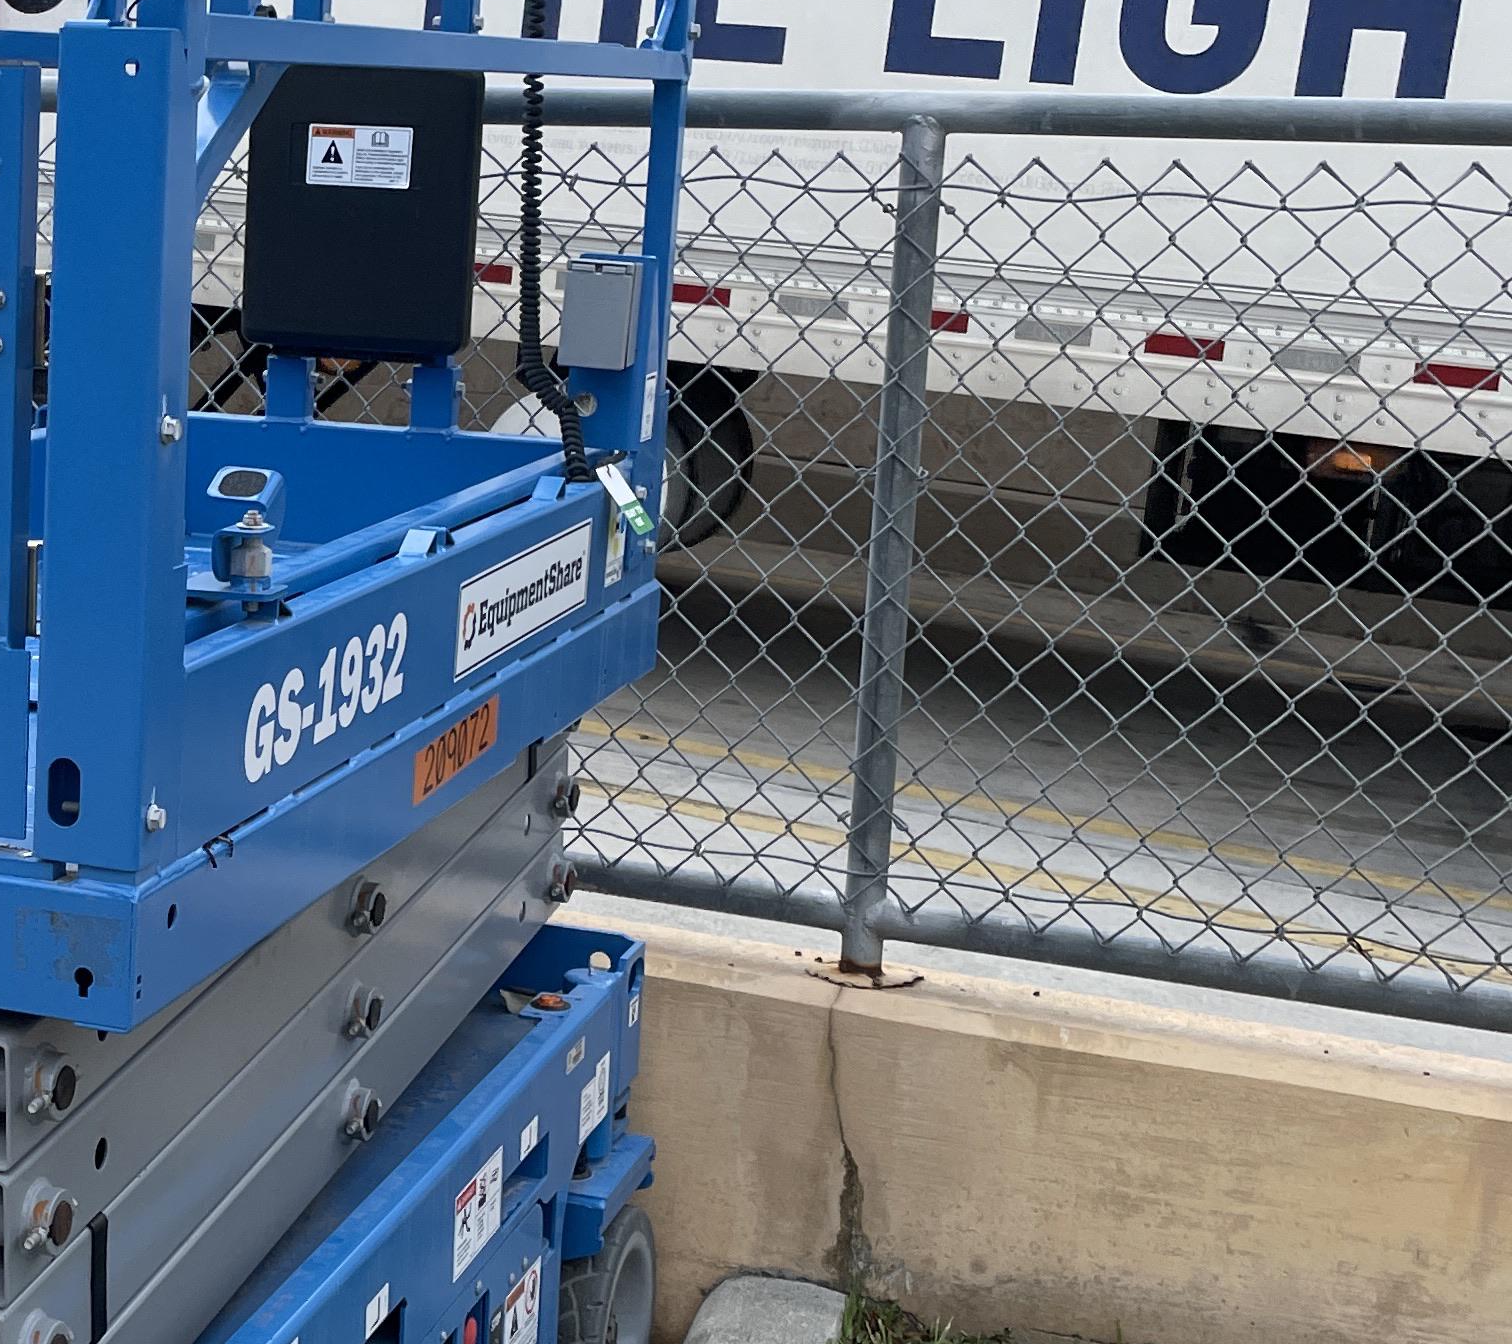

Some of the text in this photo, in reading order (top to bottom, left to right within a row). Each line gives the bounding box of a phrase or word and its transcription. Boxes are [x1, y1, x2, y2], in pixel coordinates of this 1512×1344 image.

[477, 556, 583, 638] EquipmentShare
[244, 612, 408, 783] GS-1932
[423, 703, 490, 796] 209072
